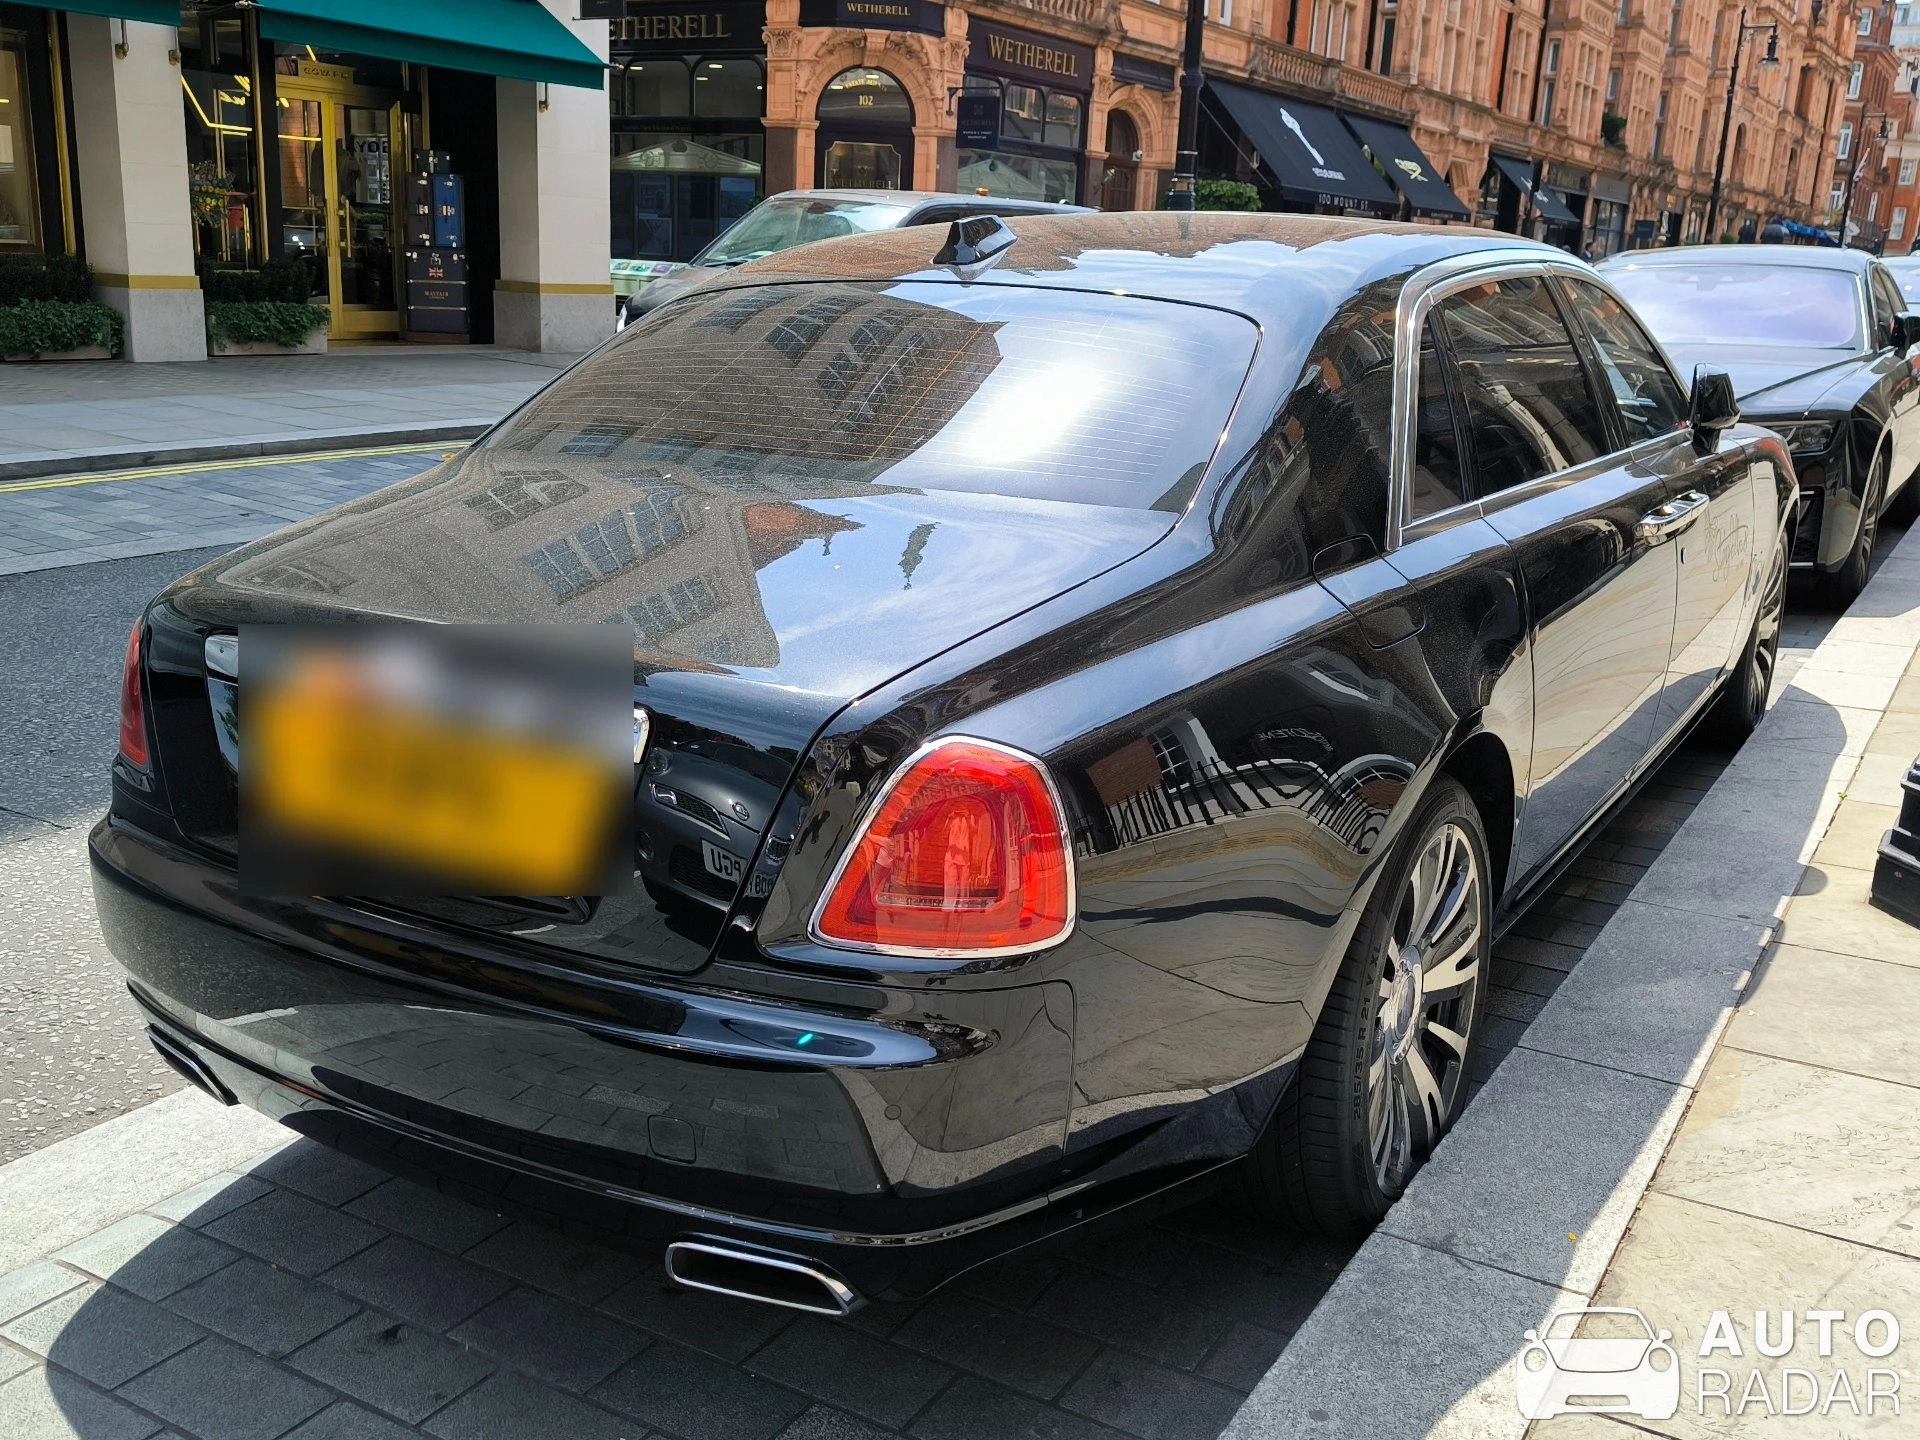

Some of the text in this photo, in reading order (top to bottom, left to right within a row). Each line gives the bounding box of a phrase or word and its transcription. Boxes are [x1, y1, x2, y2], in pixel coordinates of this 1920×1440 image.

[847, 3, 911, 16] WETHERELL
[609, 14, 731, 40] ETHERELL
[988, 34, 1078, 77] WETHERELL
[859, 95, 873, 106] 102
[1318, 193, 1331, 205] 100
[1333, 196, 1358, 208] MOUNT
[1369, 942, 1382, 968] XL
[1361, 997, 1371, 1020] 21
[1358, 1027, 1367, 1041] R
[1353, 1045, 1365, 1120] 285/35
